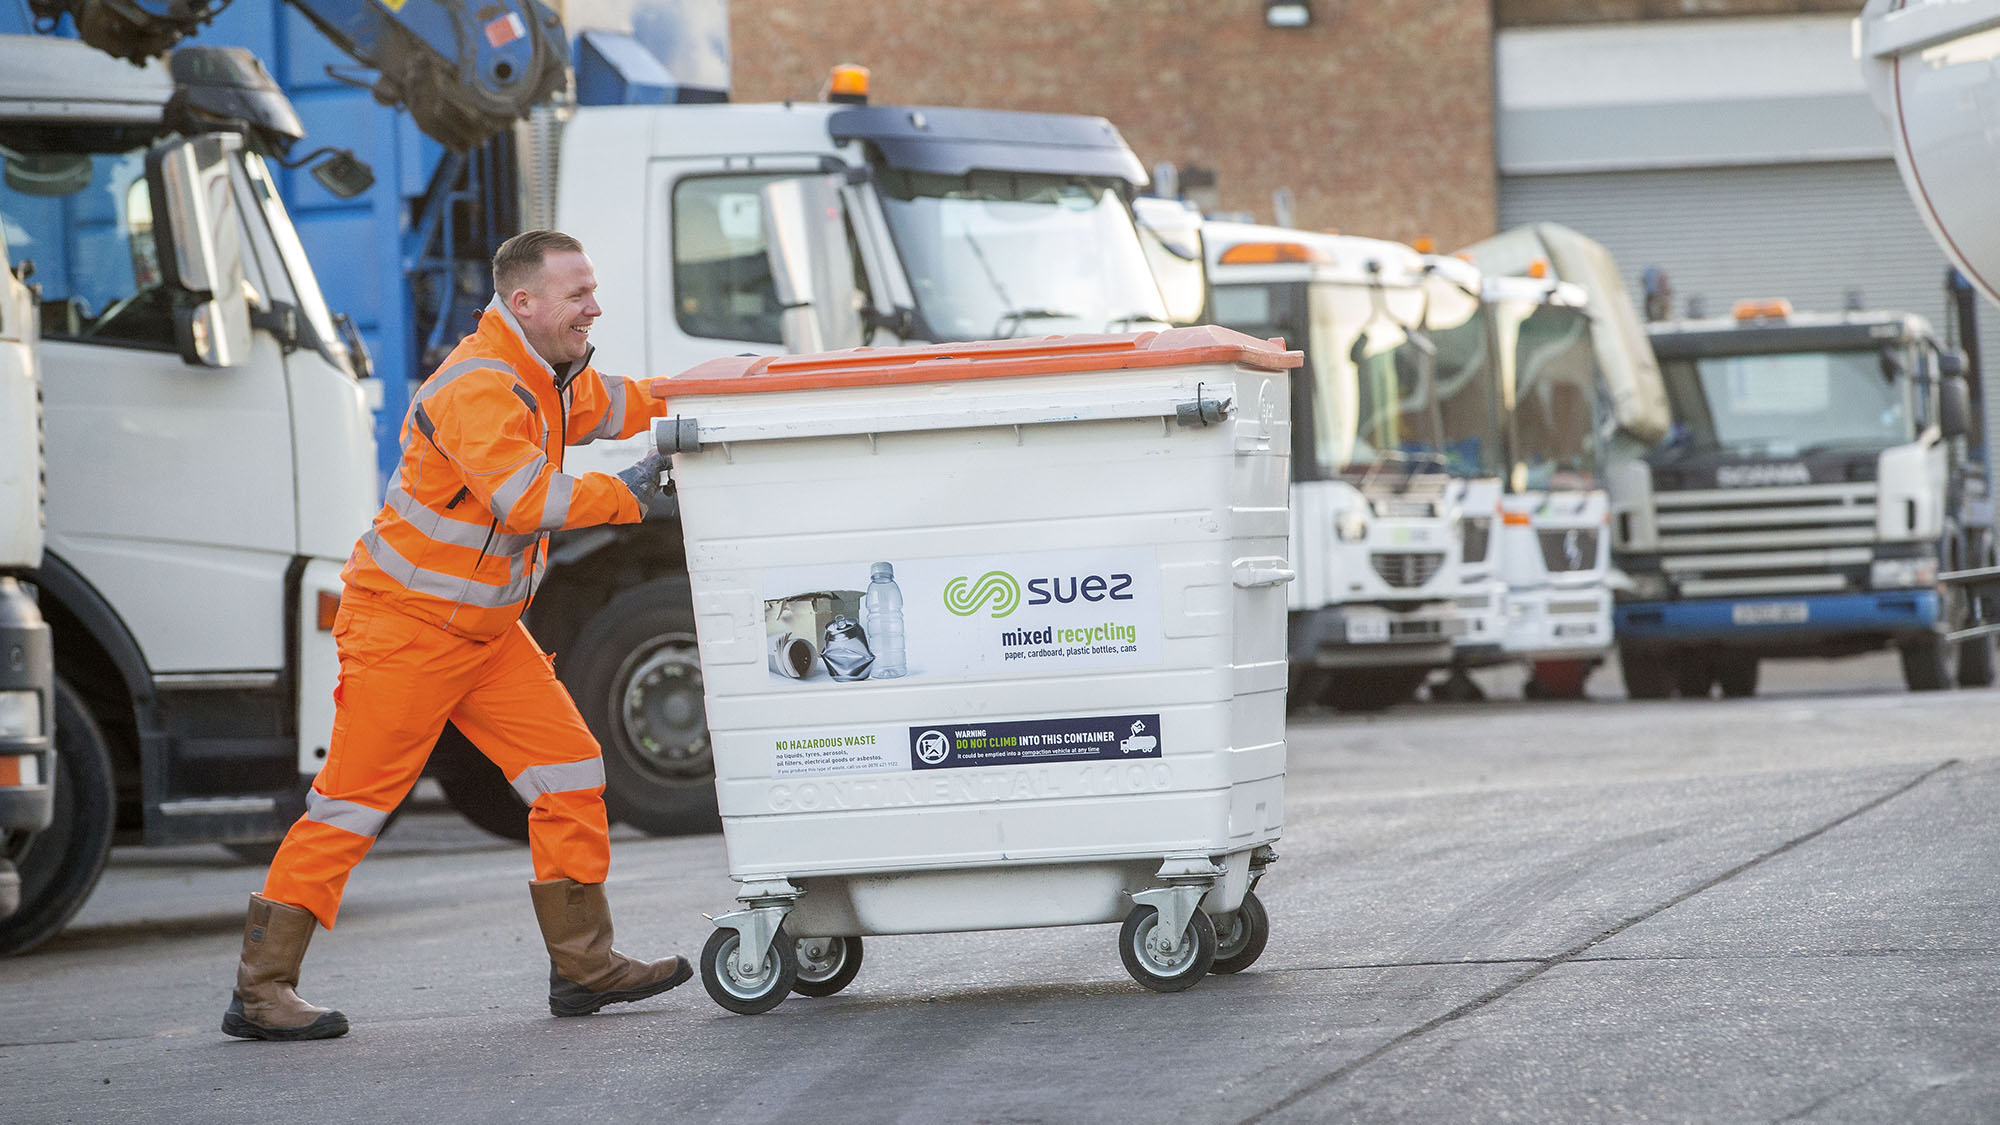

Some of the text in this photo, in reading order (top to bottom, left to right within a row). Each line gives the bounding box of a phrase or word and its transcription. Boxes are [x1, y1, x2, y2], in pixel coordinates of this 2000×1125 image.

[1002, 622, 1136, 647] mixed recycling
[1004, 644, 1137, 661] paper, cardboard, plastic bottles, cans
[955, 730, 987, 739] WARNING
[956, 731, 1115, 749] DO NOT CLIMB INTO THIS CONTAINER
[776, 735, 876, 751] NO HAZARDOUS WASTE
[784, 752, 804, 760] liquids,
[823, 749, 849, 757] aerosols,
[1022, 749, 1051, 757] compaction
[767, 763, 1174, 812] CONTINENTAL 1100
